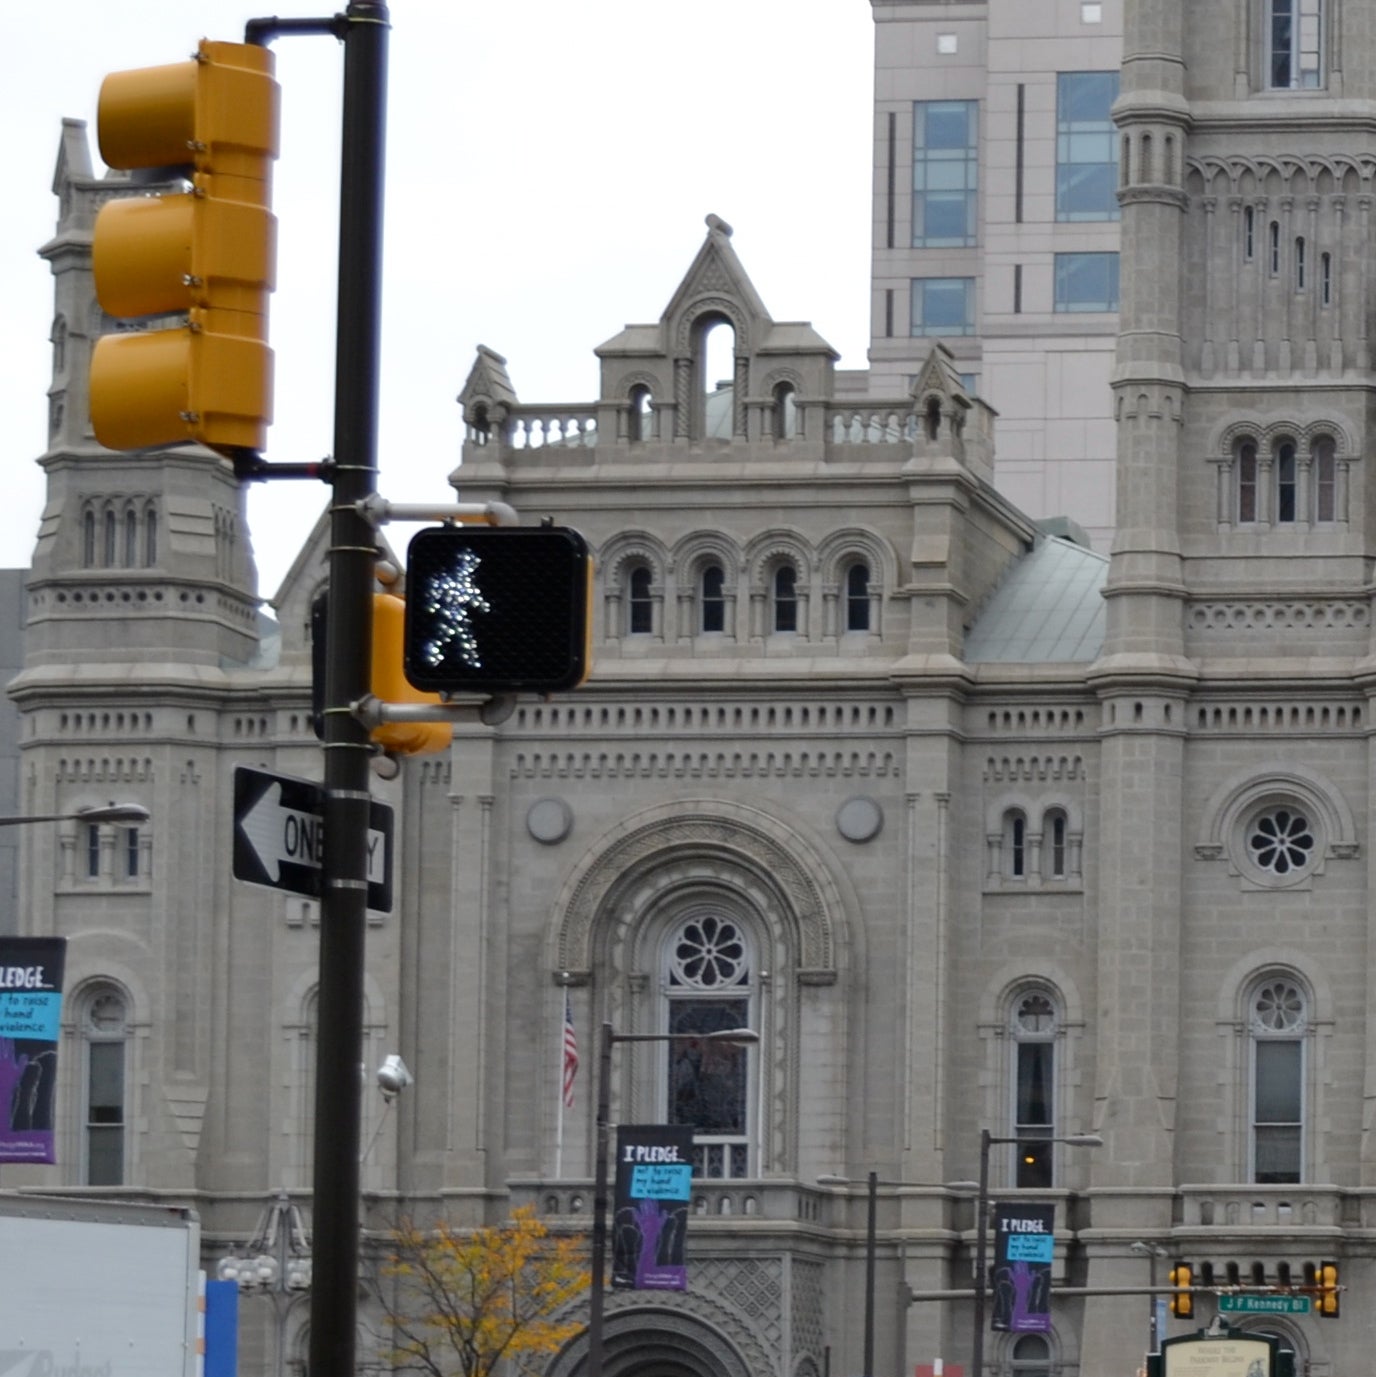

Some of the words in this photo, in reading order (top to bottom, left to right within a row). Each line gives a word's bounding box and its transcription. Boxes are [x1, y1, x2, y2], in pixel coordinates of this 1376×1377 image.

[285, 815, 324, 863] ONE
[623, 1146, 635, 1162] I
[1247, 1299, 1289, 1311] Kennedy
